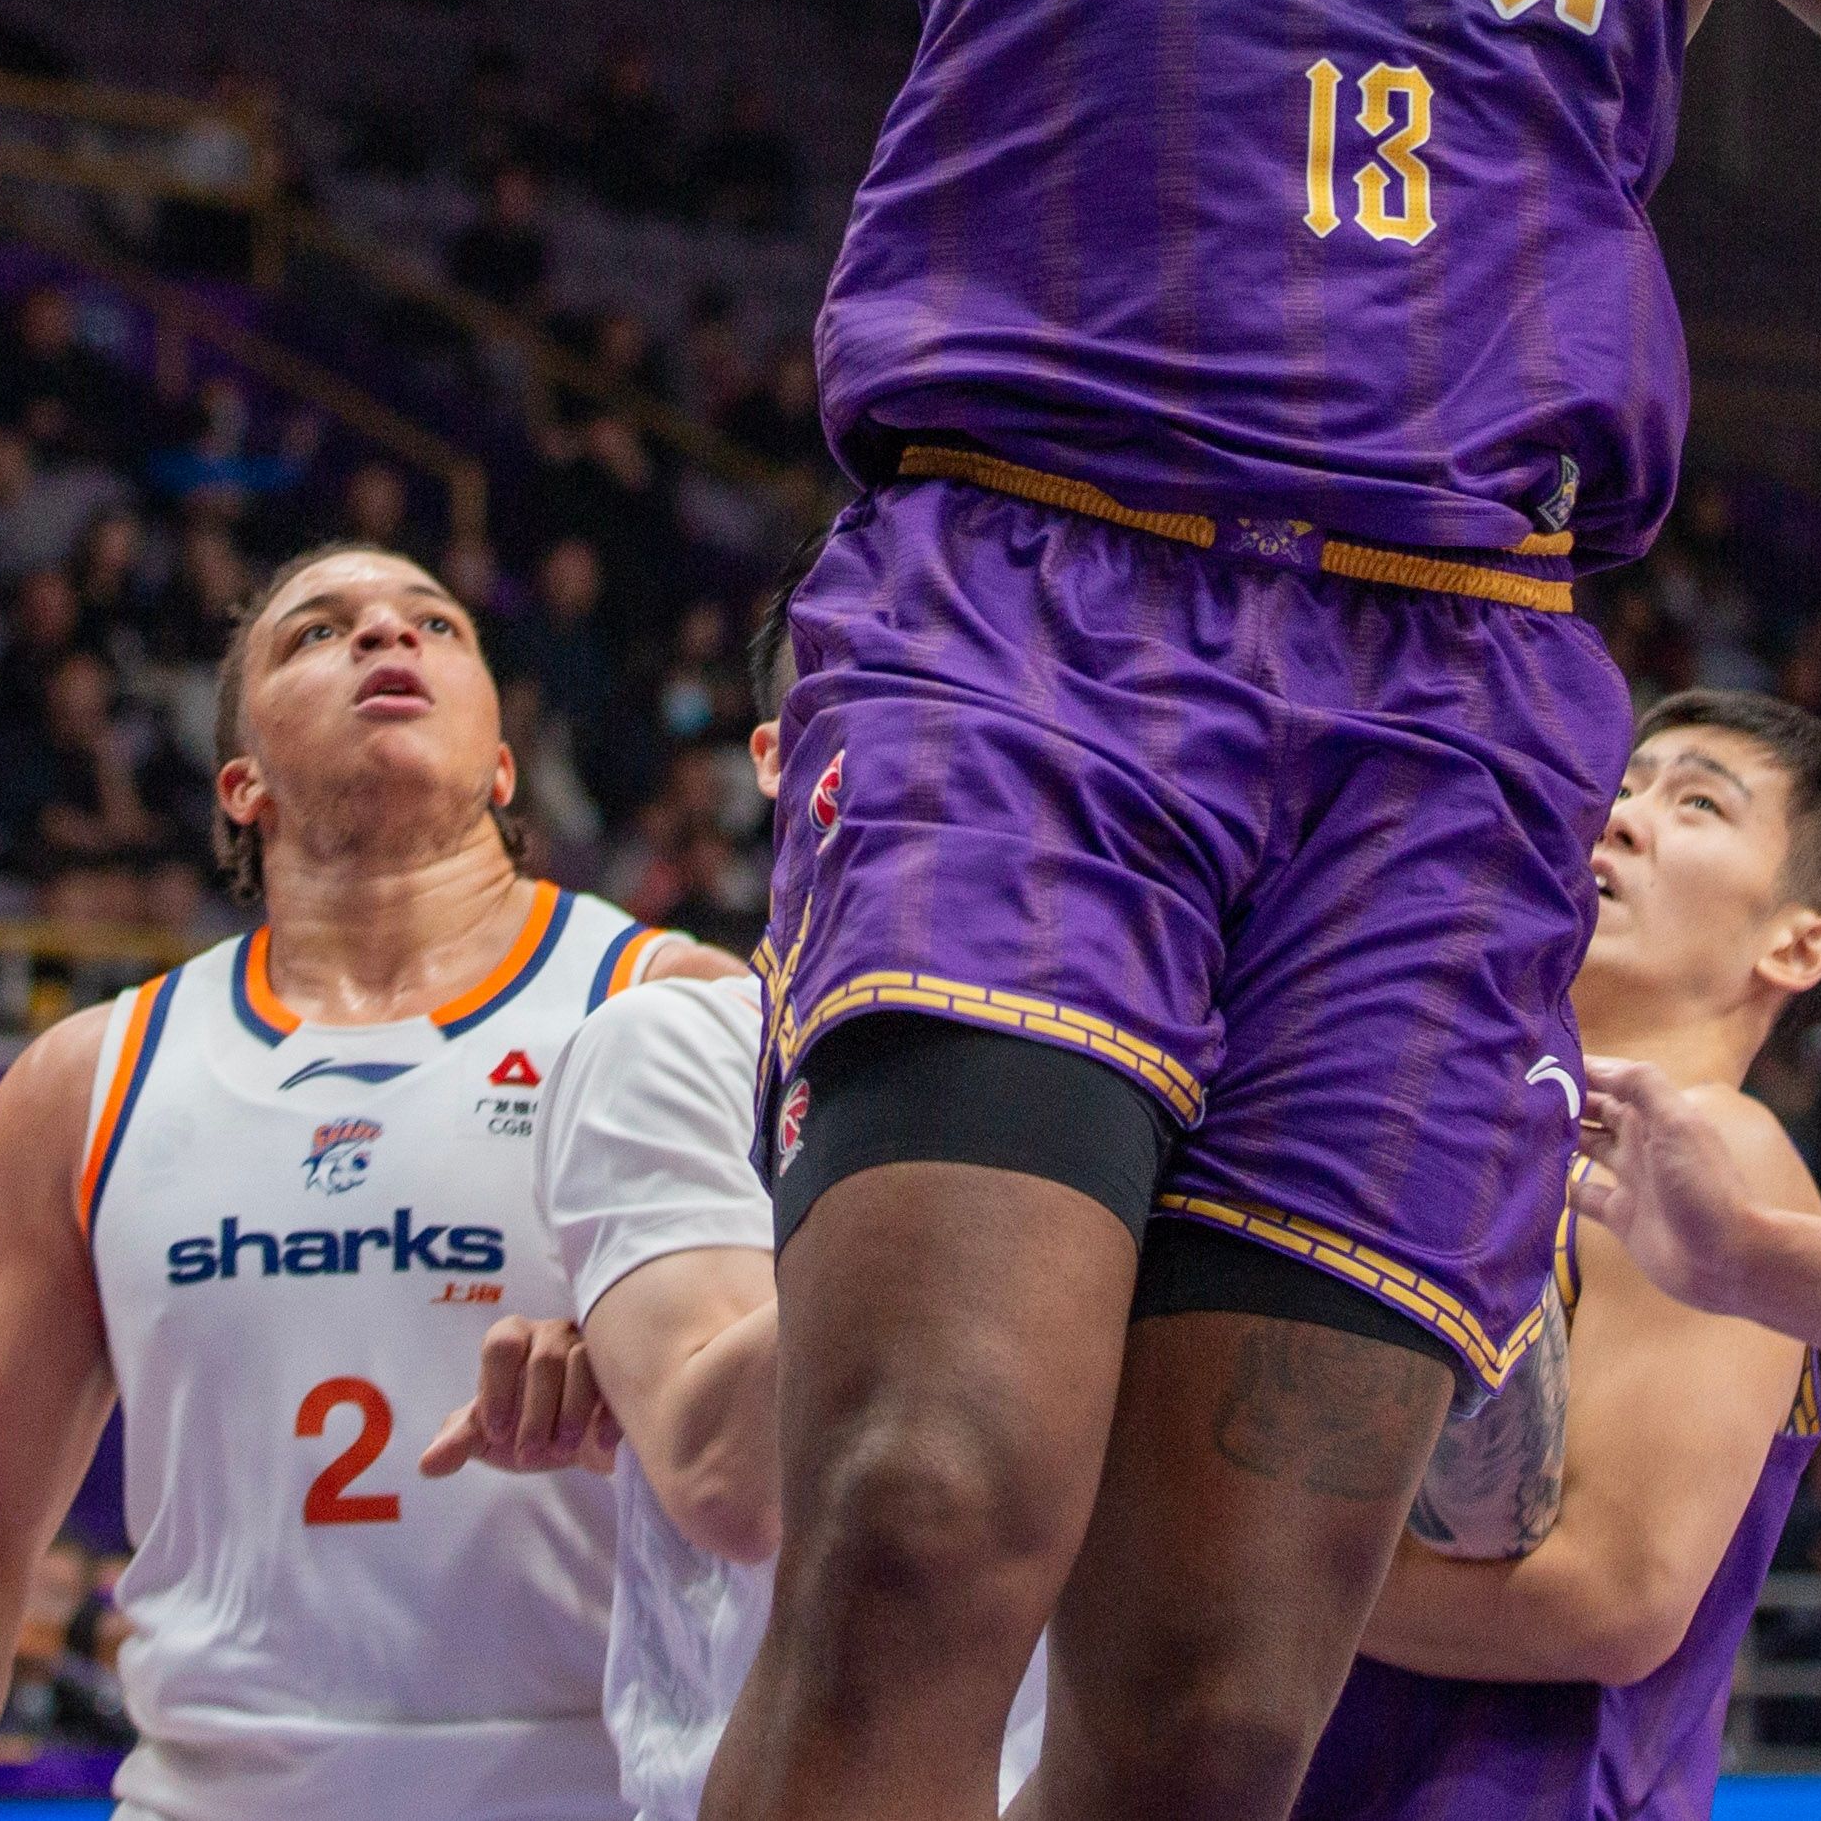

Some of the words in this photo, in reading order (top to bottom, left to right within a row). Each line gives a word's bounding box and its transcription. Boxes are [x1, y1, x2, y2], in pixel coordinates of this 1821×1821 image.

[1302, 58, 1437, 247] 13
[487, 1116, 534, 1137] CGB
[167, 1208, 506, 1286] sharks
[428, 1281, 504, 1304] 上海
[294, 1375, 401, 1526] 2
